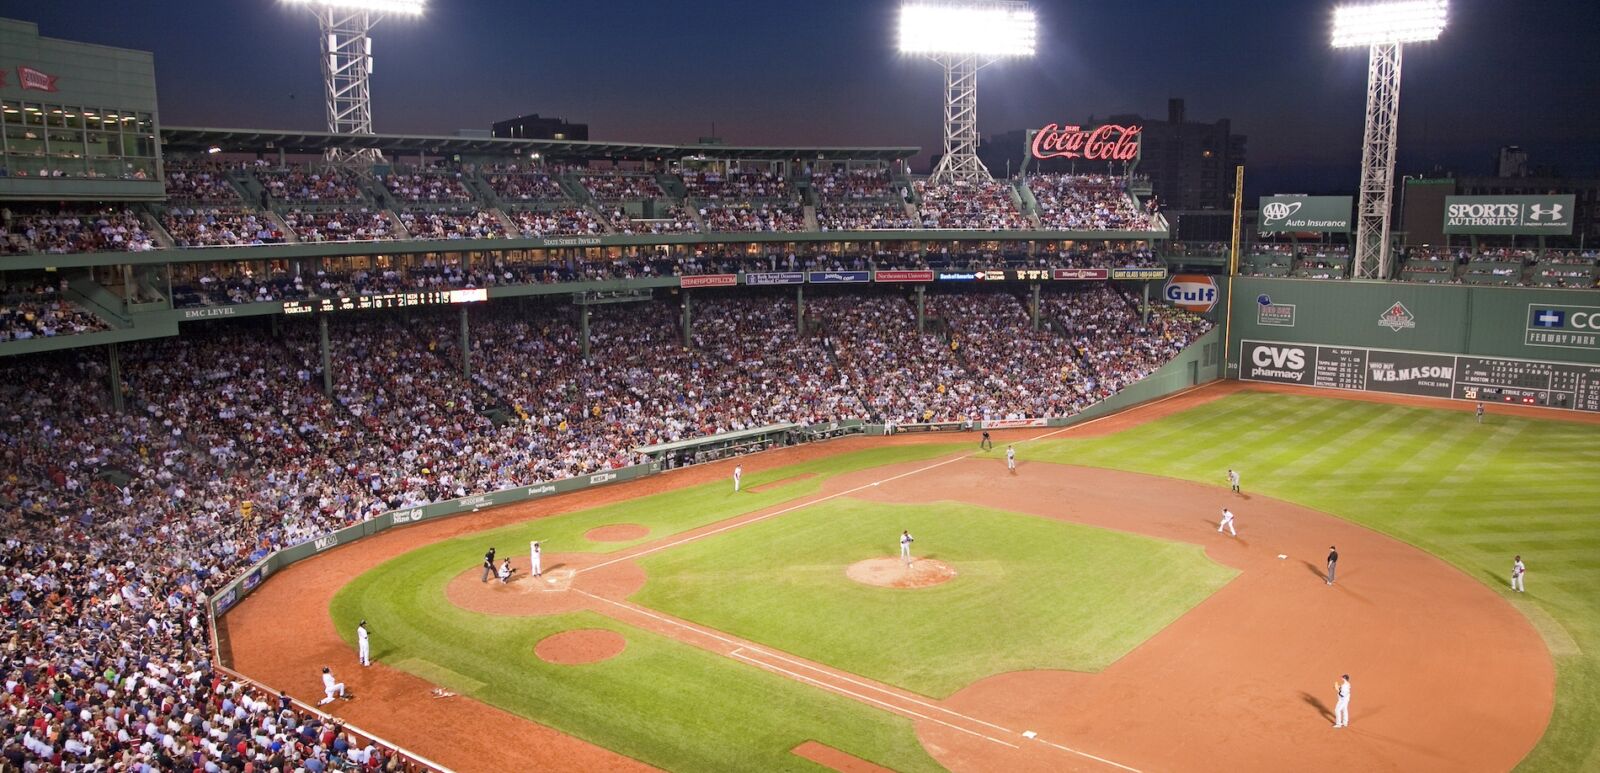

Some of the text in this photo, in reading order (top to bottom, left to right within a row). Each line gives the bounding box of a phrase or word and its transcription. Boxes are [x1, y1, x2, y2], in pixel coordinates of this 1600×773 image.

[1032, 124, 1142, 160] Coca-Cola
[1448, 204, 1518, 218] SPORTS
[1448, 218, 1518, 226] AUTHORITY
[1167, 286, 1214, 301] Gulf
[398, 298, 404, 306] 2
[208, 307, 236, 316] LEVEL
[1571, 312, 1600, 329] CO
[1531, 333, 1596, 344] FENWAY PARK
[1252, 346, 1305, 370] CVS
[1252, 368, 1304, 380] pharmacy
[1465, 391, 1476, 399] 20
